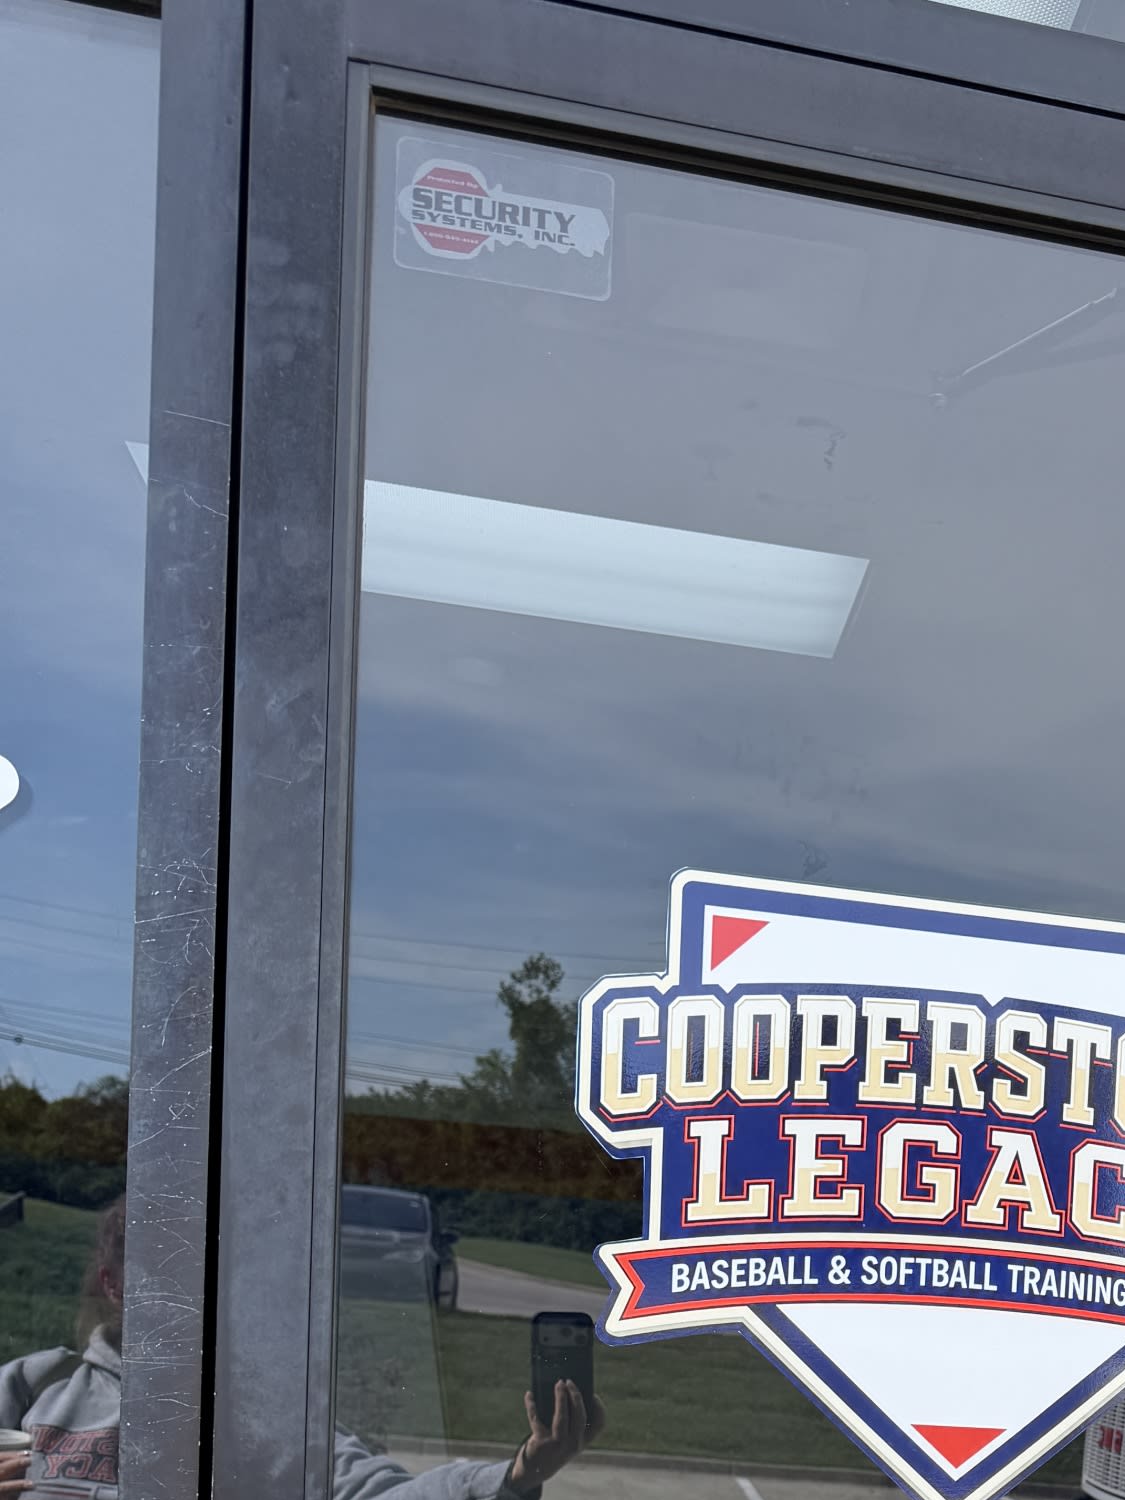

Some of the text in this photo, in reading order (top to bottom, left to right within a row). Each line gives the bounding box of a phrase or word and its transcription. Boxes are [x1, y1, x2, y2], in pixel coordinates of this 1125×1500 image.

[412, 187, 576, 234] SECURITY
[412, 209, 524, 239] SYSTEMS,
[534, 230, 576, 247] INC.
[671, 1255, 818, 1293] BASEBALL
[828, 1255, 851, 1285] &
[861, 1255, 998, 1291] SOFTBALL
